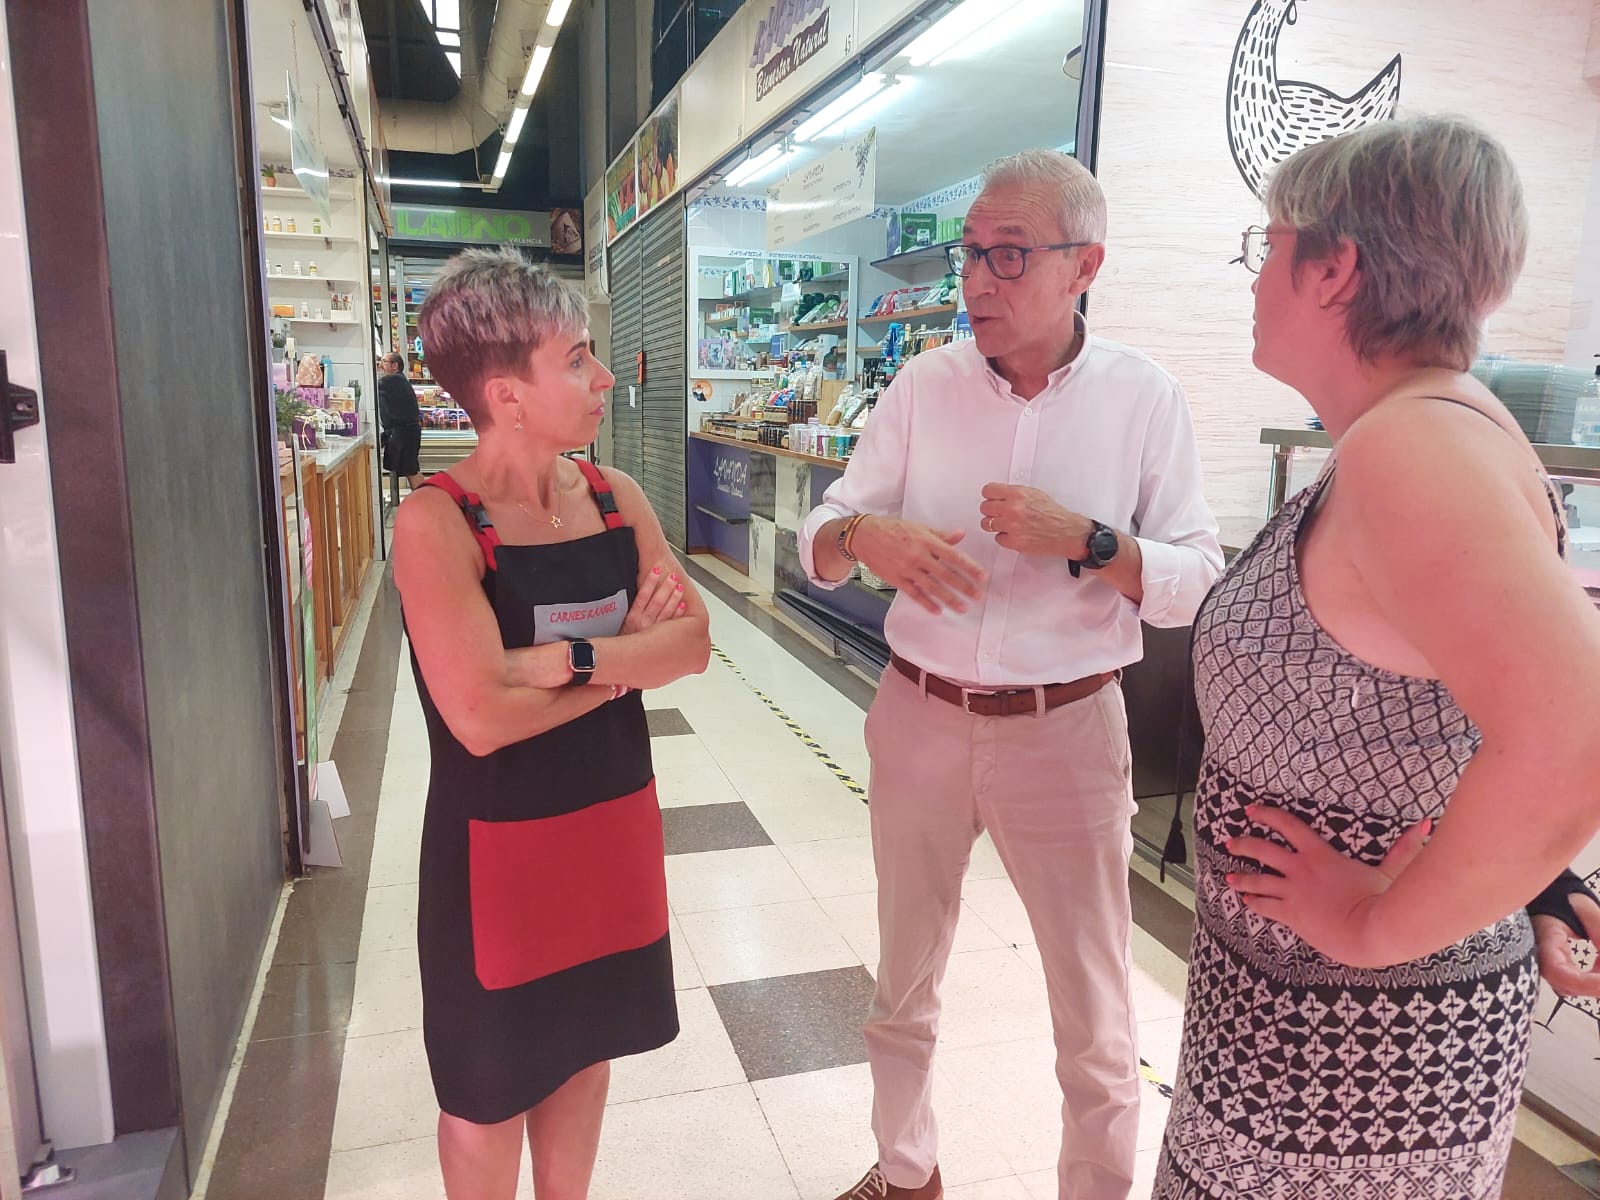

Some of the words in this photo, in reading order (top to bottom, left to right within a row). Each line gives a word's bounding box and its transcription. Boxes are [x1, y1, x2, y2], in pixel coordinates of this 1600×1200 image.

[793, 9, 829, 67] Natural
[396, 206, 531, 240] LATINO
[549, 608, 587, 623] CARNES
